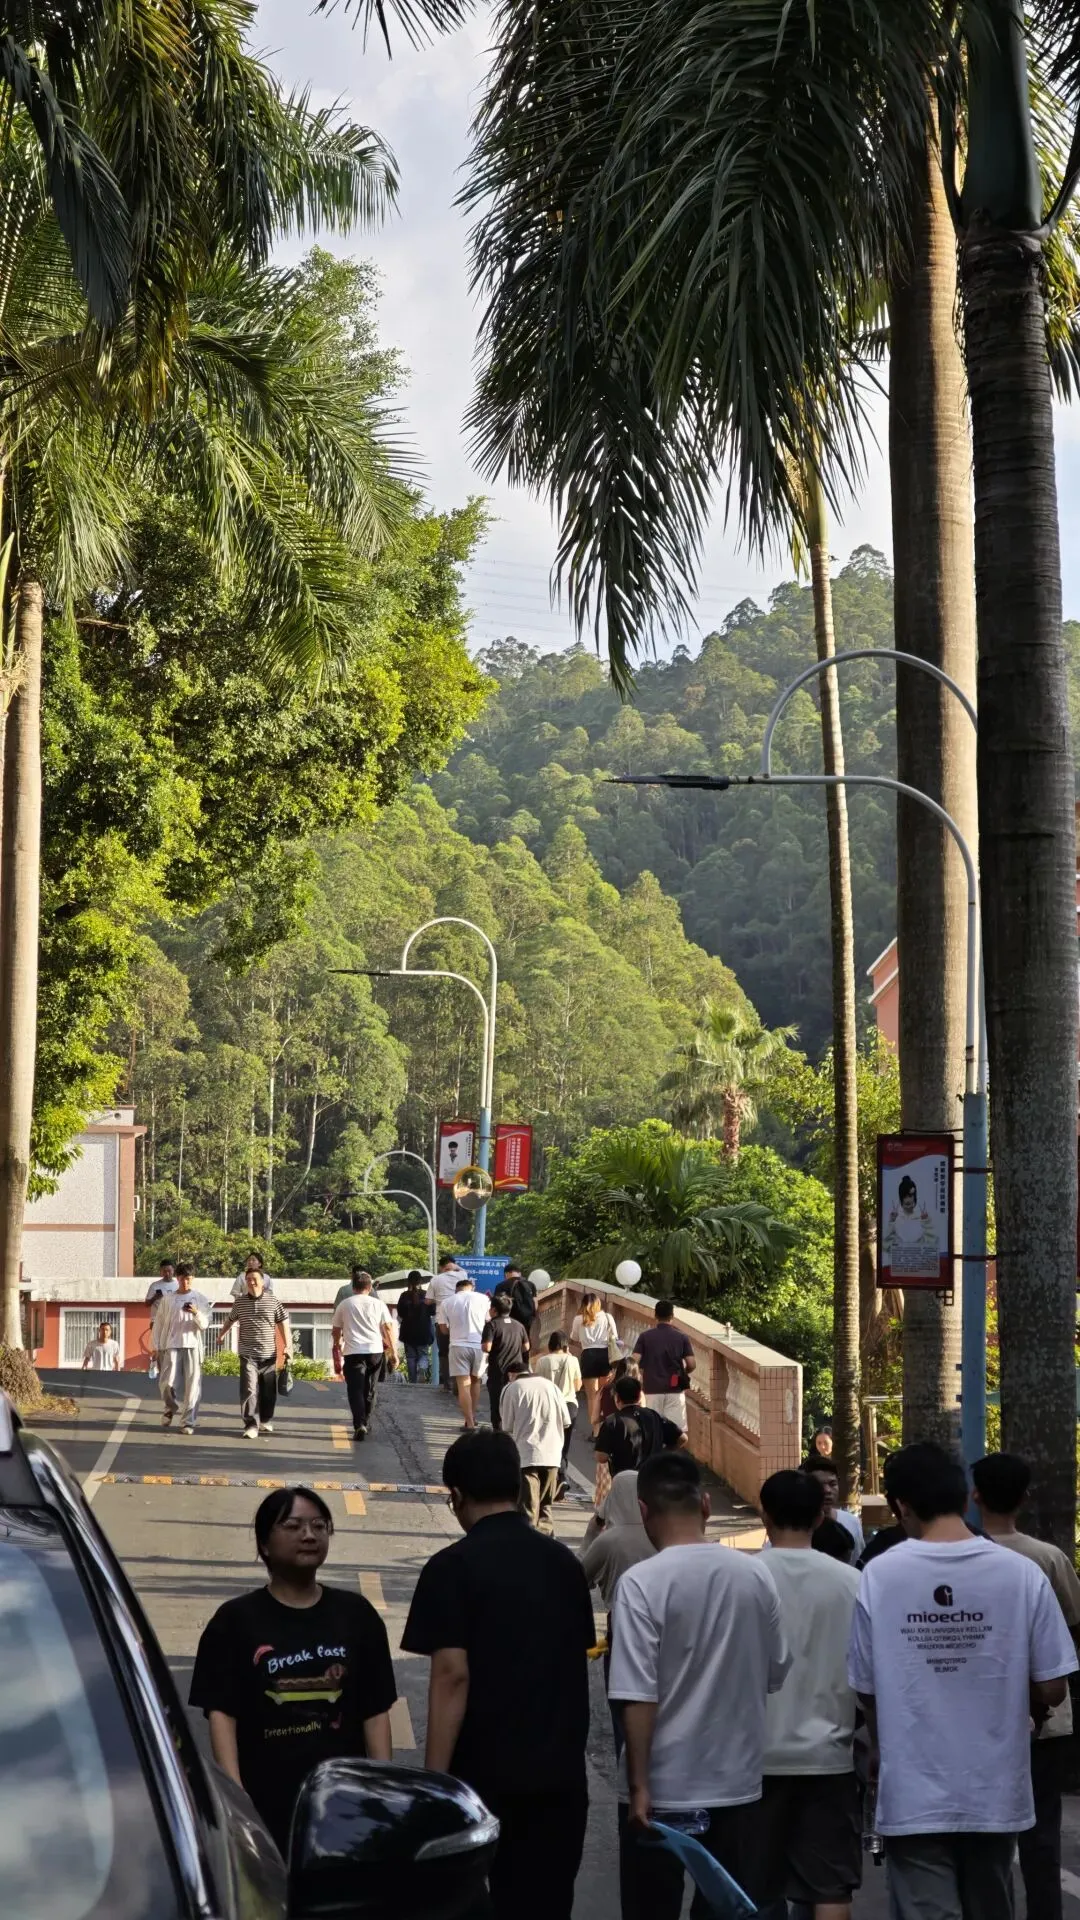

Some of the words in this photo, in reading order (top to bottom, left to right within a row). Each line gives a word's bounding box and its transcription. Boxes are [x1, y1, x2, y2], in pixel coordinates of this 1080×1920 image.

[907, 1611, 984, 1623] mioecho
[267, 1650, 313, 1674] Break
[316, 1645, 347, 1658] fast
[264, 1721, 322, 1738] Intentionally
